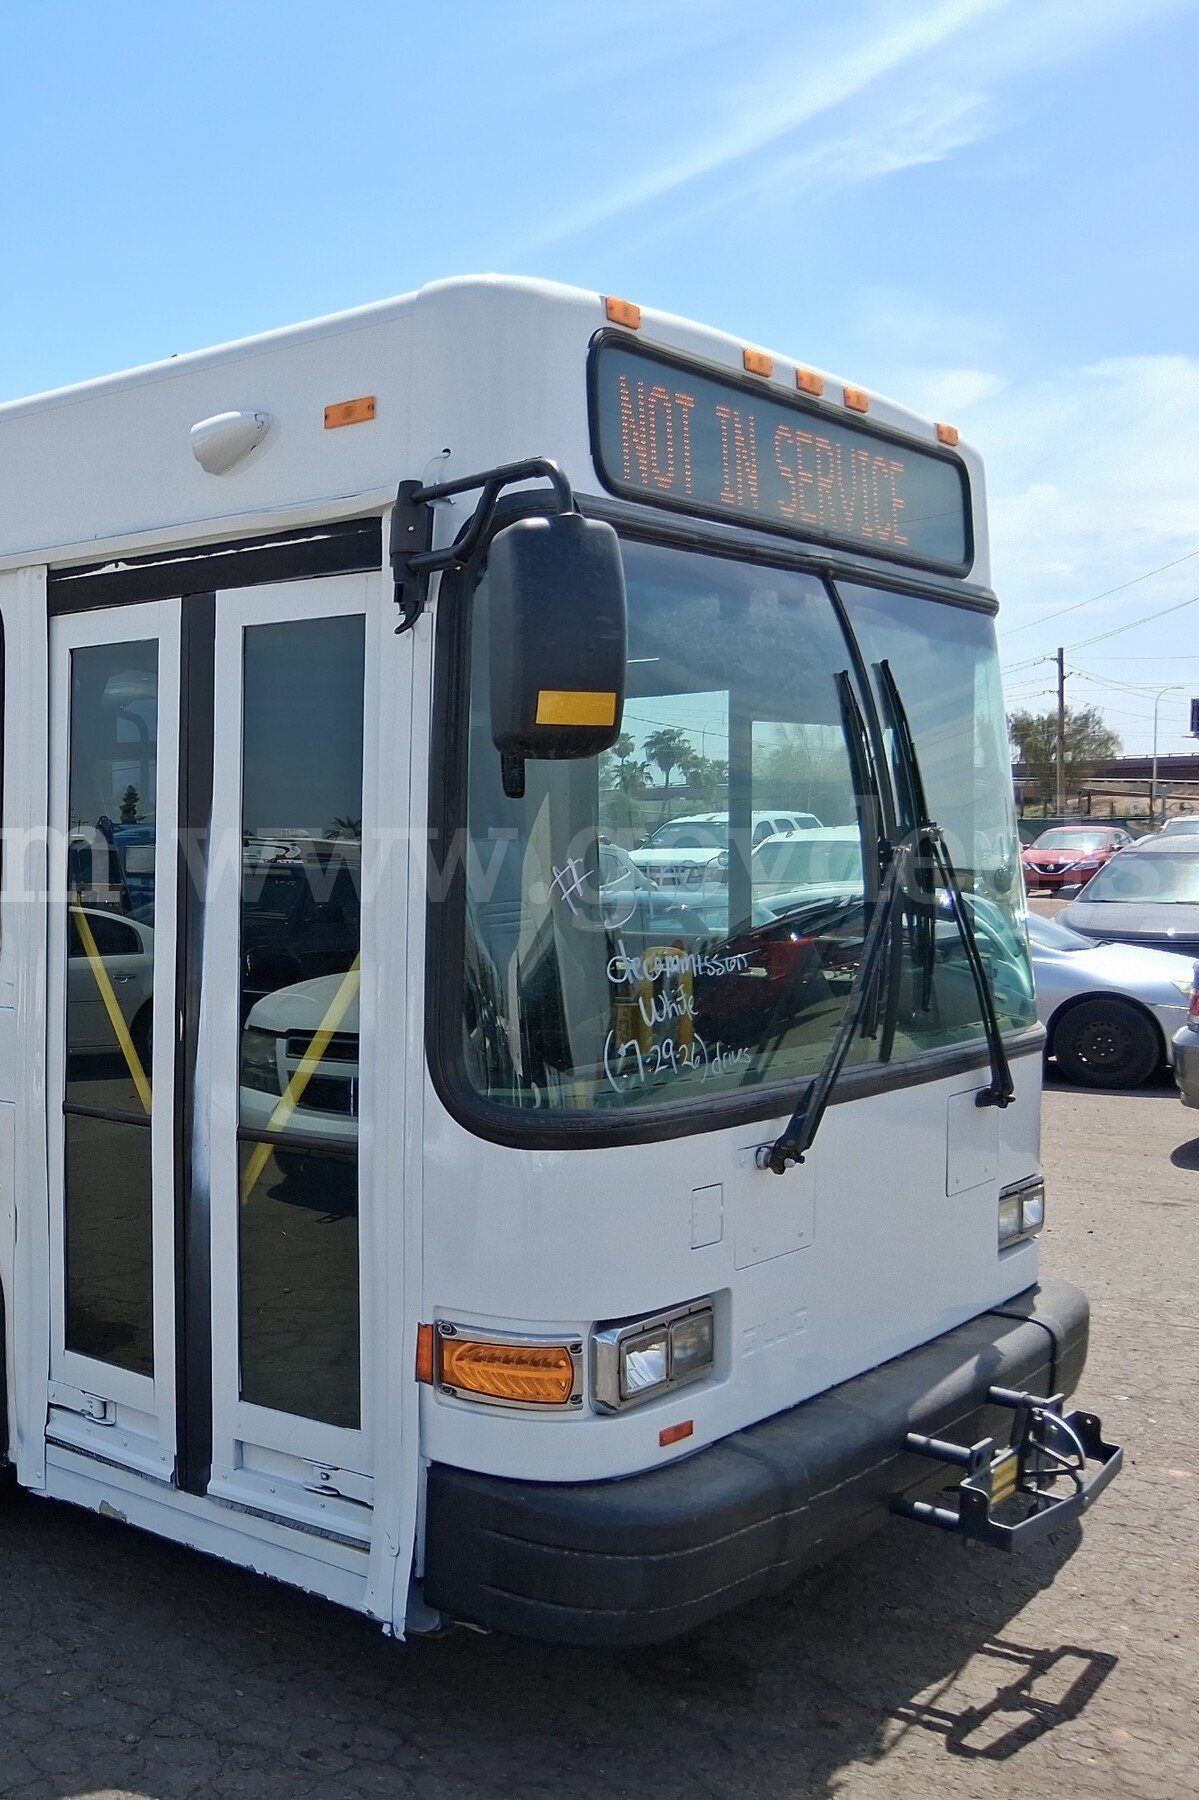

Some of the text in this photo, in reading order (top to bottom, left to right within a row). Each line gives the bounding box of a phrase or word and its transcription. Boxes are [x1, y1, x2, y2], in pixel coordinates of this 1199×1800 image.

[618, 375, 910, 547] NOT IN SERVICE
